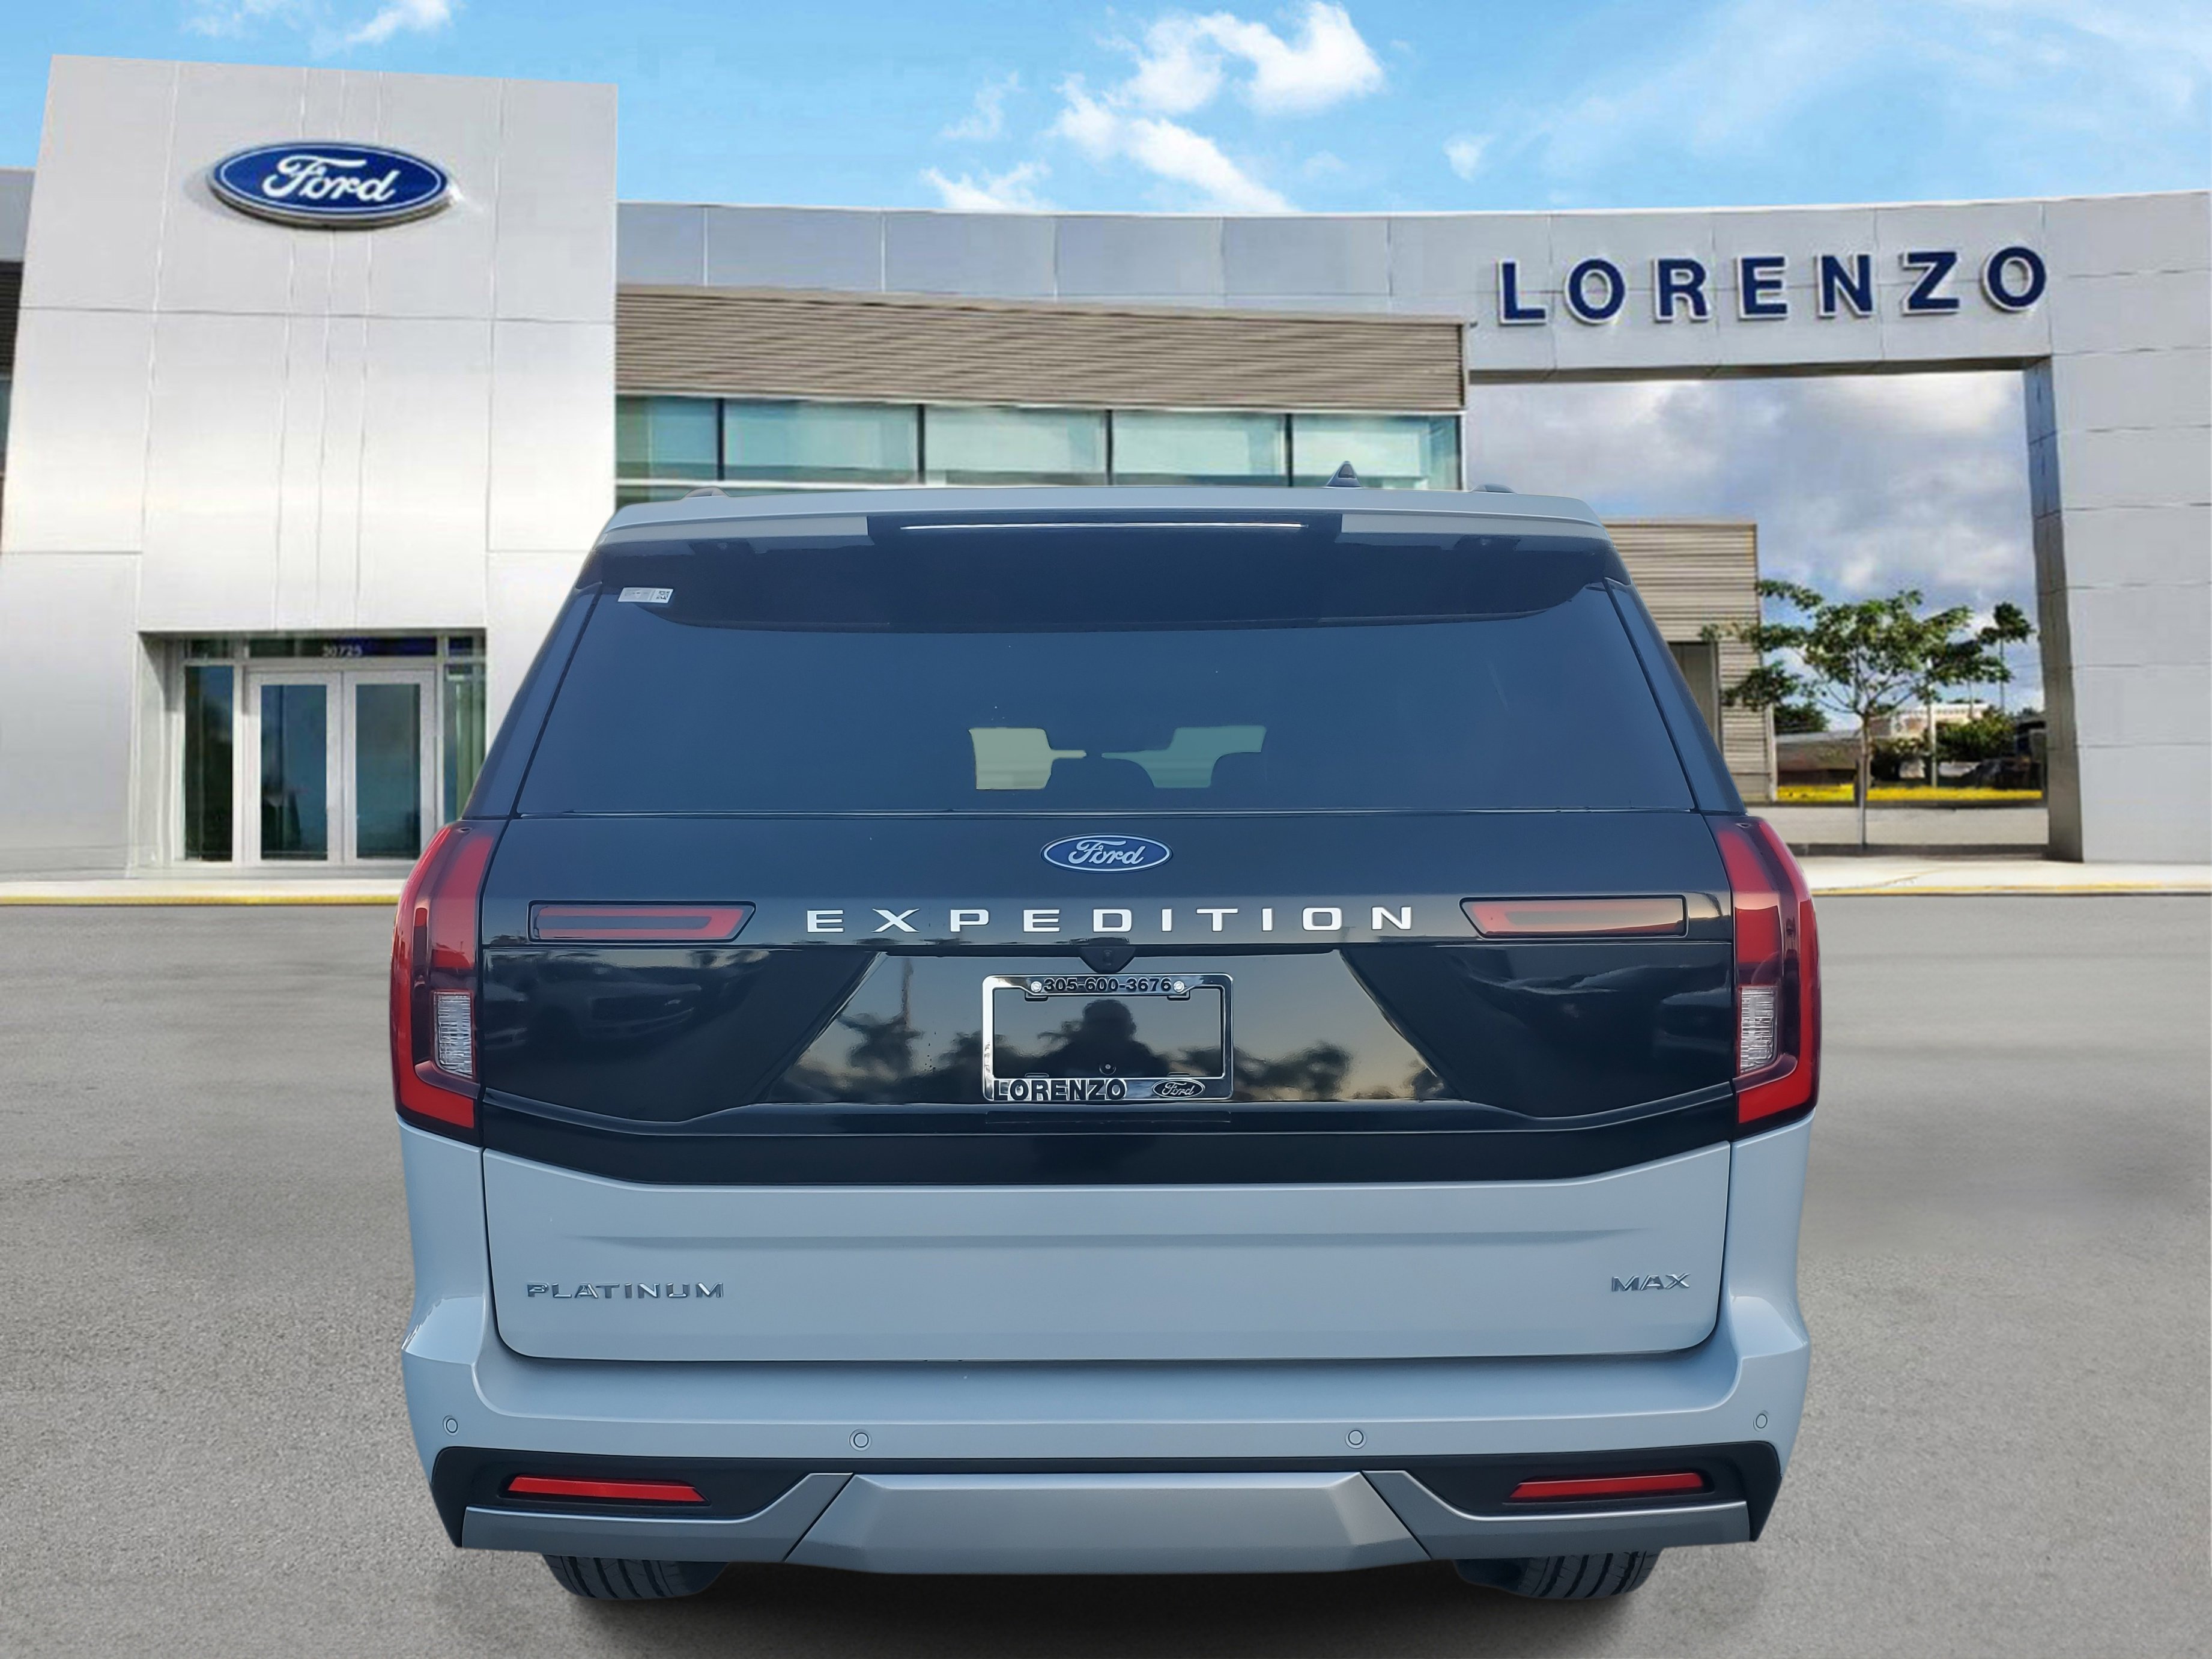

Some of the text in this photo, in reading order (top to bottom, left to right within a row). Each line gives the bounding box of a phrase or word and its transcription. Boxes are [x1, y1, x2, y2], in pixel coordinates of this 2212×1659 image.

[262, 154, 401, 202] Ford
[1497, 246, 2047, 325] LORENZO
[1067, 839, 1147, 866] Ford
[806, 905, 1413, 933] EXPEDITION
[1043, 977, 1172, 992] 305-600-3676
[993, 1078, 1127, 1102] LORENZO
[1161, 1084, 1196, 1097] Ford
[526, 1282, 724, 1299] PLATINUM
[1611, 1272, 1691, 1293] MAX
